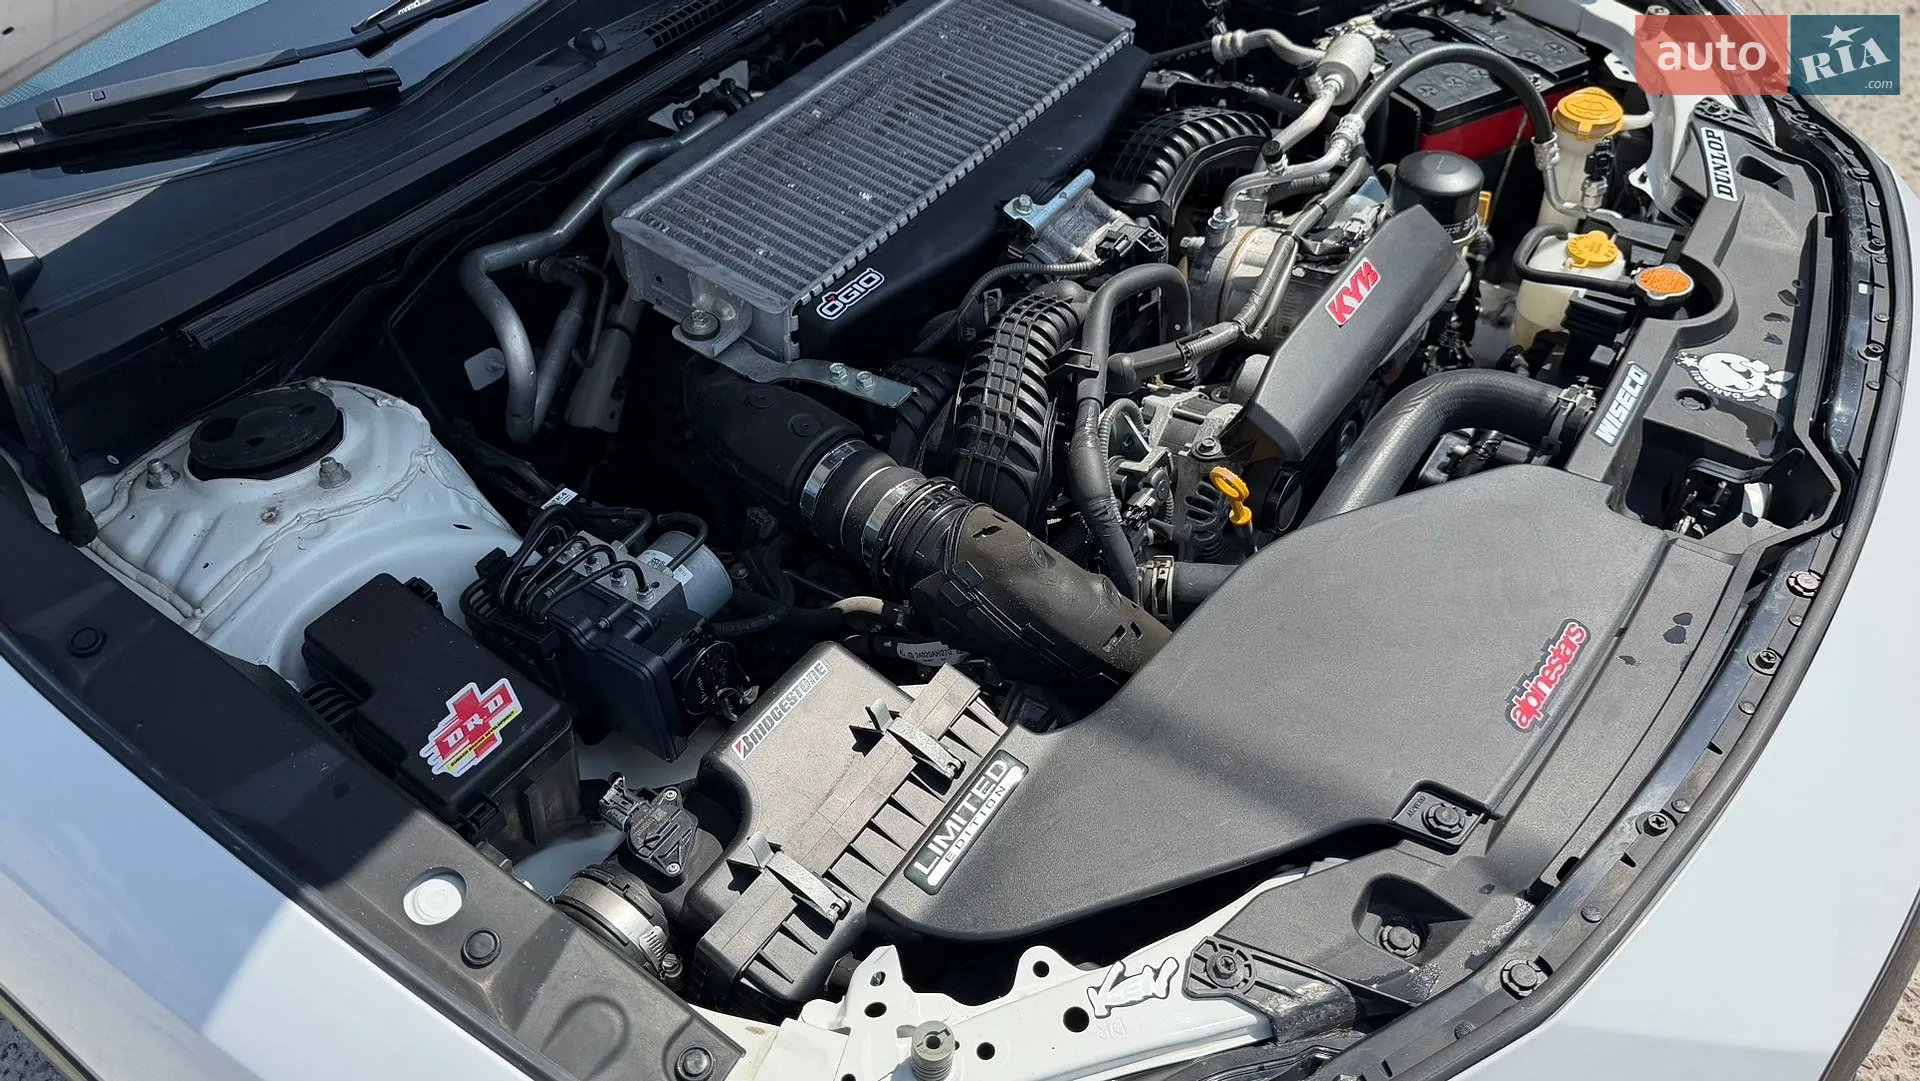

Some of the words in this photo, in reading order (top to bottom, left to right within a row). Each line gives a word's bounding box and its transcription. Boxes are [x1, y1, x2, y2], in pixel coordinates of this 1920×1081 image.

[1704, 129, 1734, 199] DUNLOP
[1326, 260, 1379, 325] KYB
[1594, 363, 1650, 445] WISECO
[735, 661, 827, 759] BRIDGESTONE
[1510, 621, 1587, 729] alpinestars
[913, 760, 1008, 875] LIMITED
[944, 785, 1006, 863] EDITION
